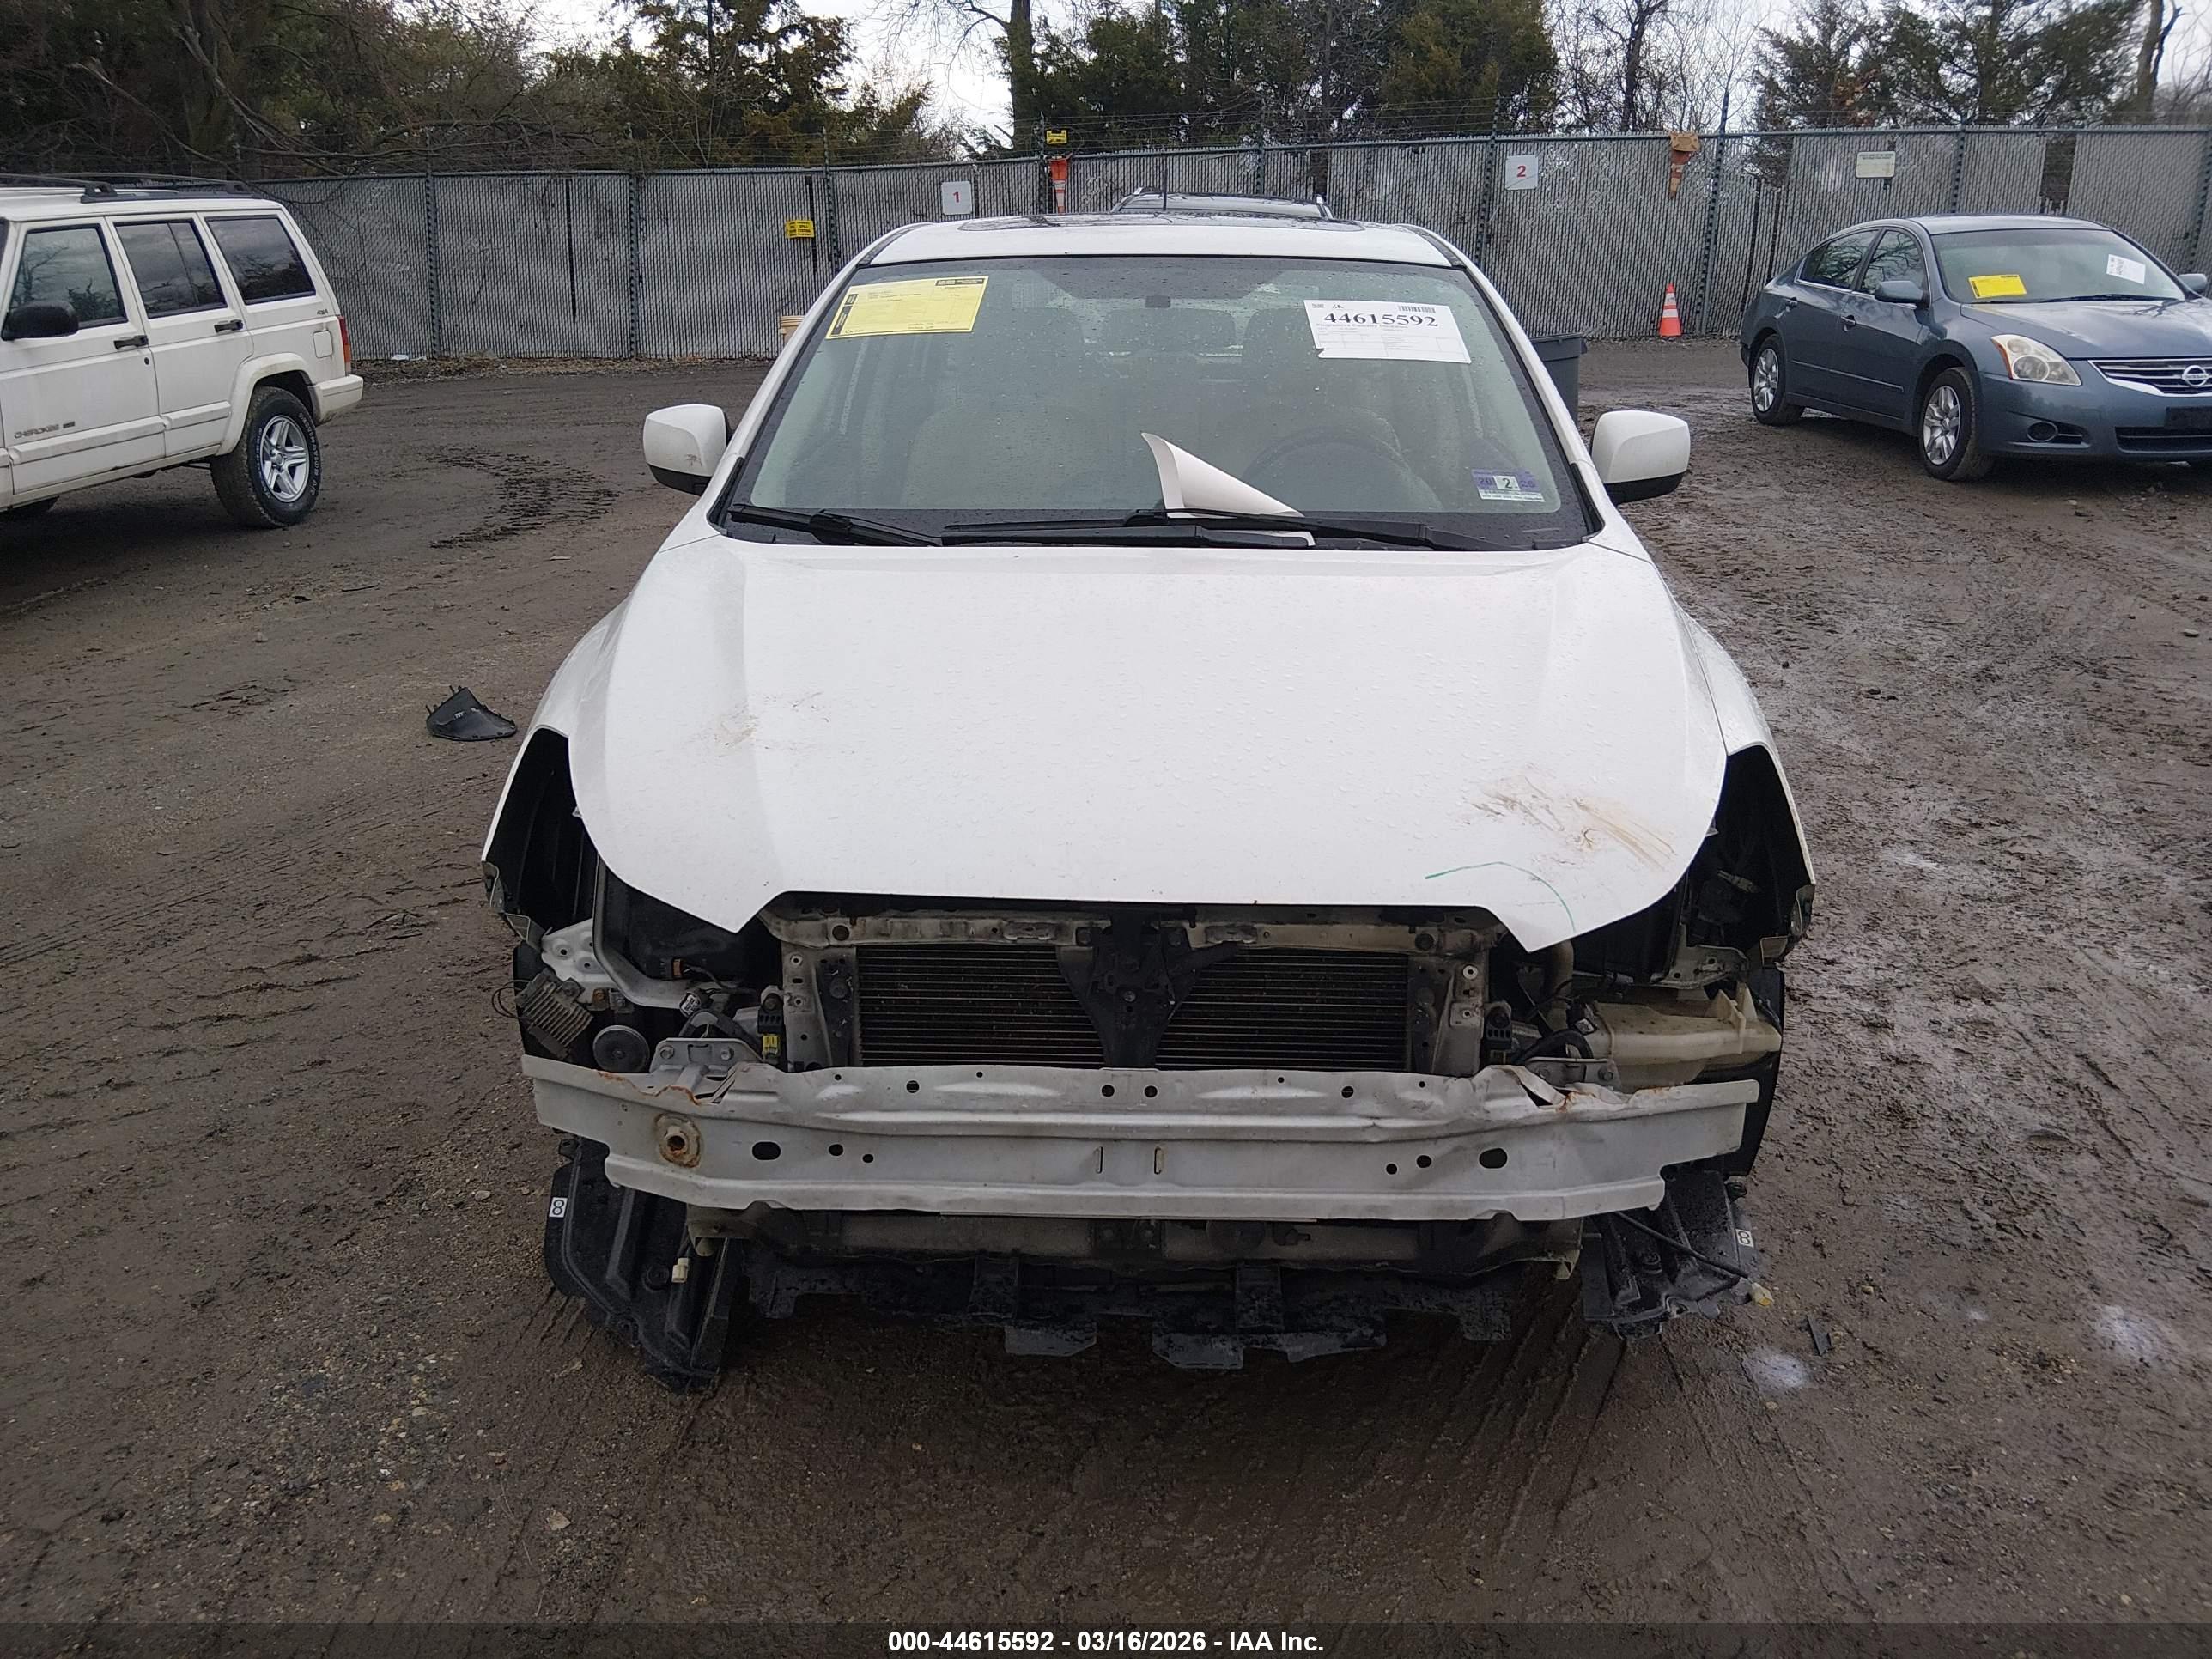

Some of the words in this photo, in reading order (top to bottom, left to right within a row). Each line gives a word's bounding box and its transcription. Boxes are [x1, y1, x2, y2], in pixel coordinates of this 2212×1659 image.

[1516, 165, 1526, 178] 2
[953, 191, 960, 204] 1
[1324, 313, 1438, 326] 44615592
[1503, 478, 1513, 489] 2
